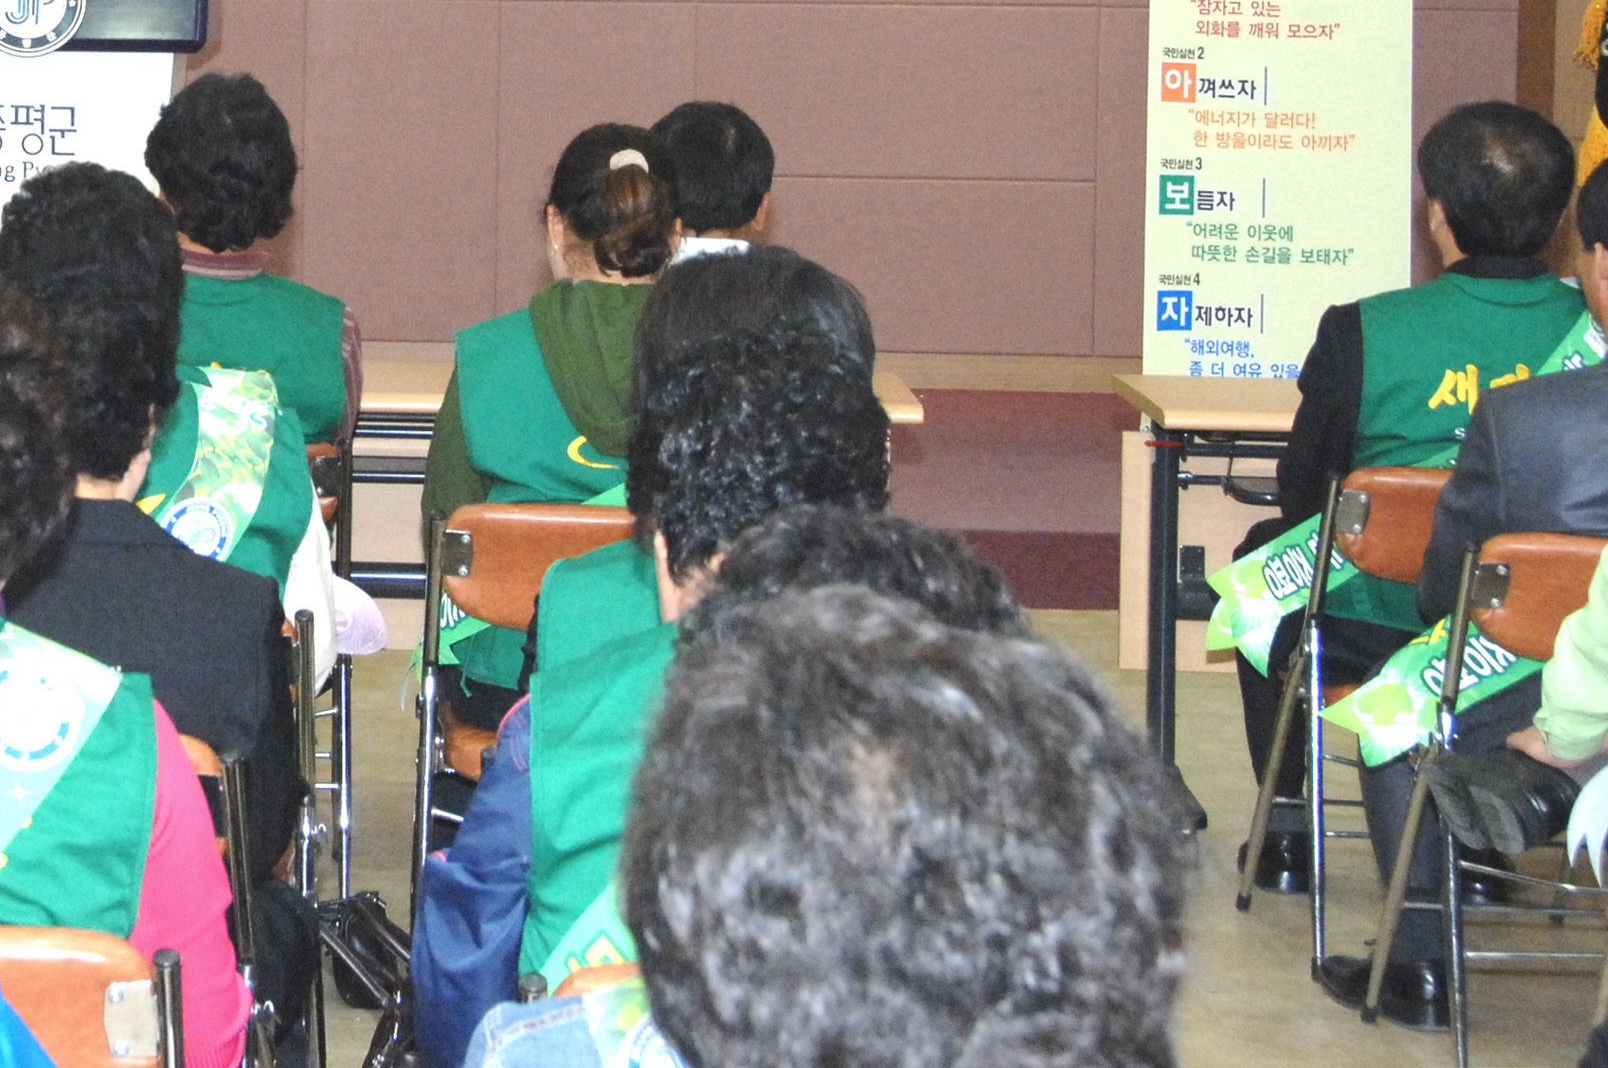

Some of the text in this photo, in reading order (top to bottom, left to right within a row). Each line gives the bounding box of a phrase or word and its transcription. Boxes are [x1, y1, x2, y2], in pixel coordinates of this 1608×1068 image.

[1250, 0, 1282, 19] 있는
[1195, 19, 1241, 39] 외화를
[1248, 22, 1280, 40] 깨워
[1197, 46, 1205, 60] 2
[1193, 130, 1209, 148] 한
[1195, 157, 1203, 171] 3
[1246, 223, 1294, 243] 이웃에
[1191, 244, 1238, 263] 따뜻한
[1244, 246, 1292, 265] 손길을
[1158, 272, 1201, 286] 국민실천 4
[1210, 362, 1225, 378] 더
[1233, 362, 1263, 378] 여유
